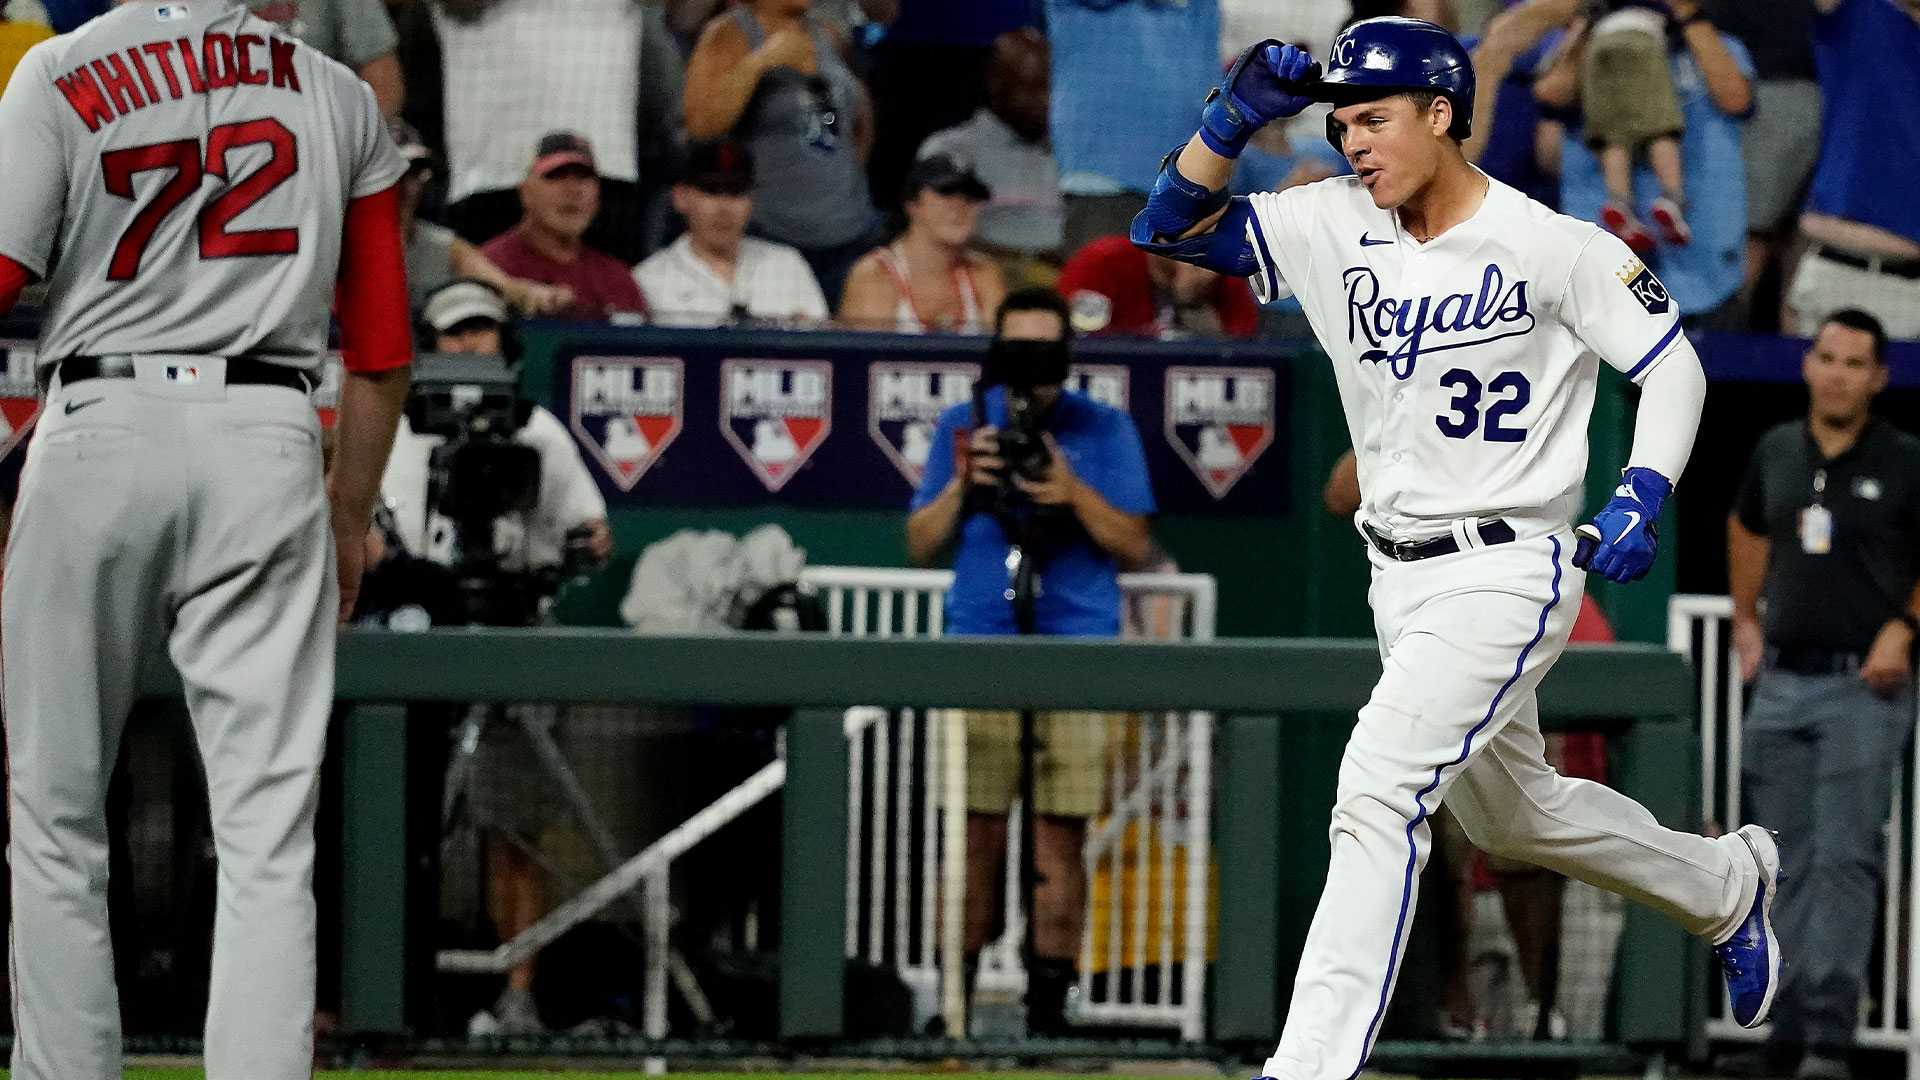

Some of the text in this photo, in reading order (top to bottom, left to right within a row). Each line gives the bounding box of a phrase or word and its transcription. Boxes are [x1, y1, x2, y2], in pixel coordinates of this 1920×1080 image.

[1331, 33, 1356, 66] KC
[55, 31, 302, 133] WHITLOCK
[101, 117, 299, 281] 72
[1631, 279, 1667, 307] KC
[1342, 263, 1536, 380] Royals
[580, 366, 675, 402] MLB
[732, 369, 823, 404] MLB
[1174, 378, 1266, 410] MLB
[1436, 368, 1531, 443] 32
